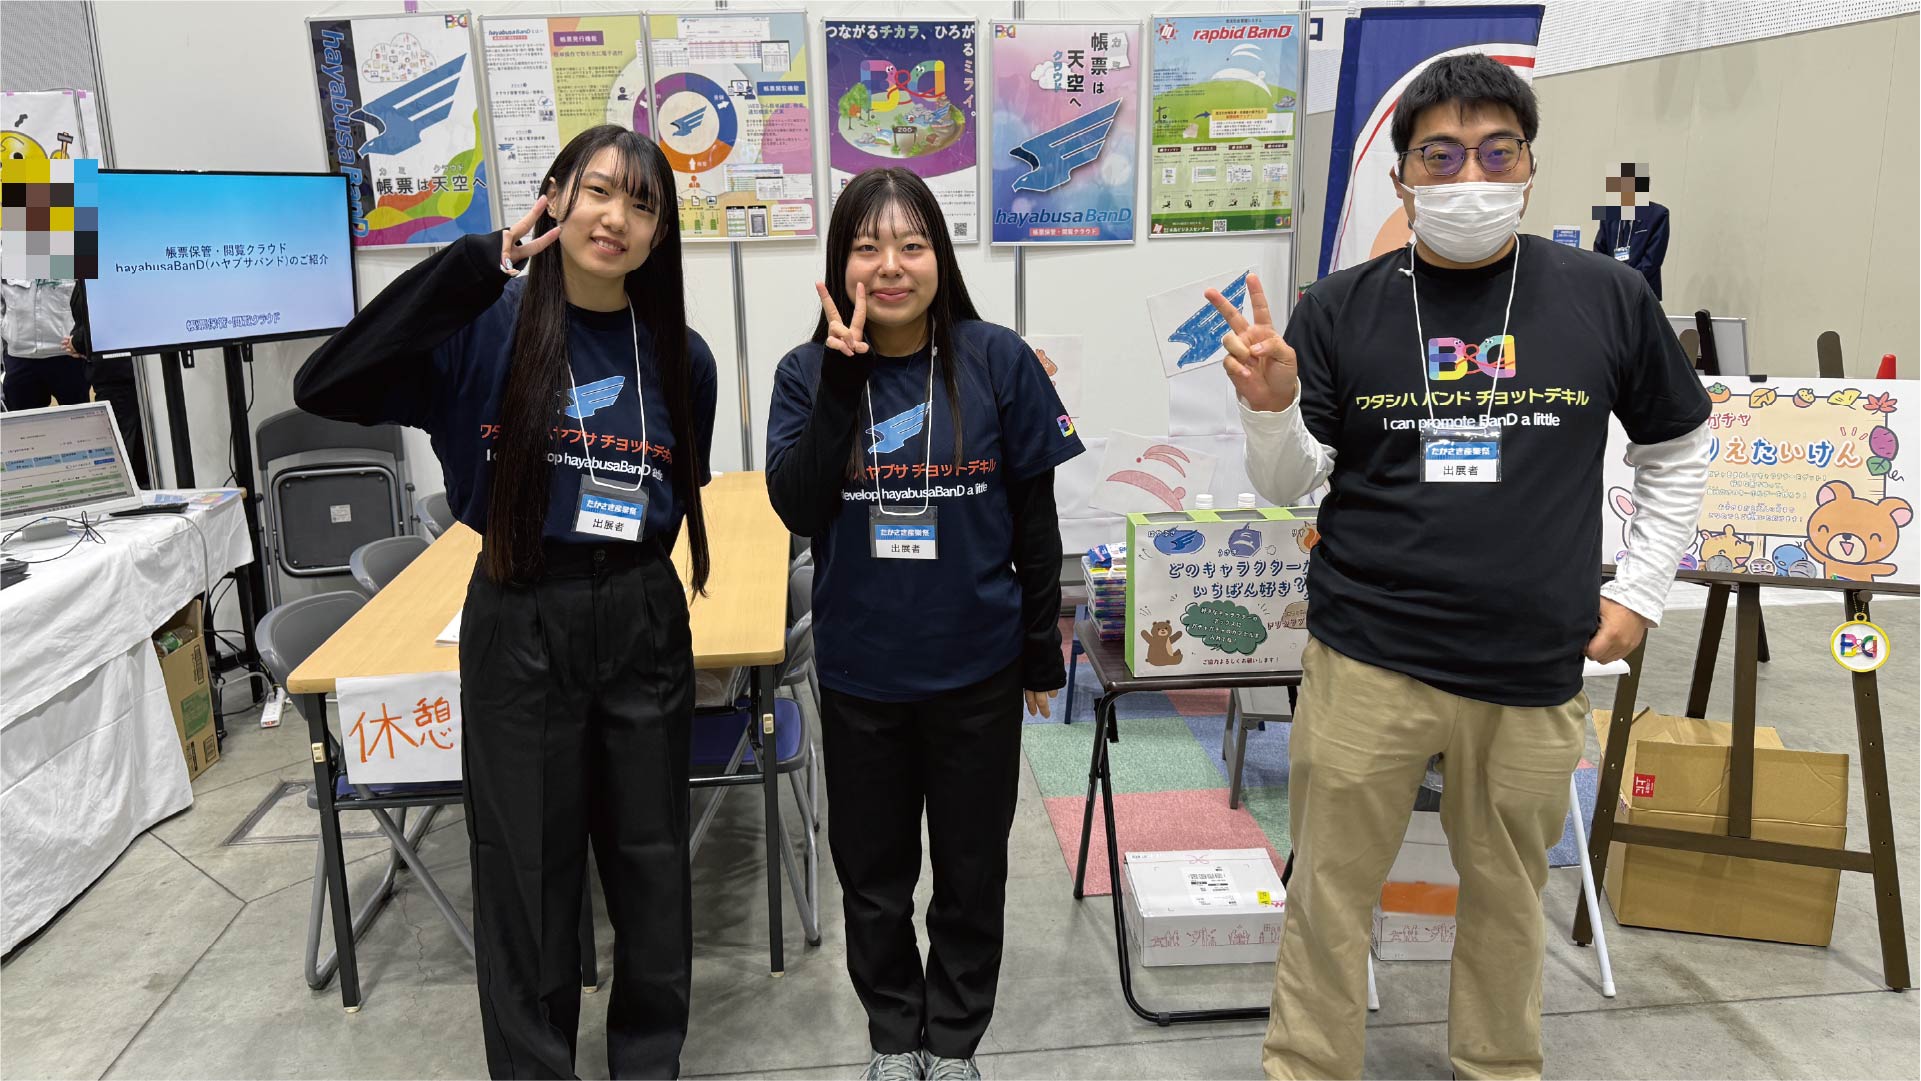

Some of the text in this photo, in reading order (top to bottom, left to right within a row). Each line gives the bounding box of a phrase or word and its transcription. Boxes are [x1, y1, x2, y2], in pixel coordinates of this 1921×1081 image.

[825, 24, 975, 40] つながるチカラ、ひろが
[1192, 26, 1244, 43] rapbid
[1246, 25, 1294, 39] BanD
[1091, 32, 1109, 95] 帳票は
[1067, 49, 1084, 107] 天空へ
[376, 175, 487, 195] 帳票は天空へ
[995, 208, 1132, 229] hayabusa BanD
[165, 242, 287, 259] 帳票保管・閲覧クラウド
[1355, 387, 1590, 411] ワタシハ バンド チョットデキル
[1390, 418, 1416, 430] can
[1521, 415, 1531, 426] a
[1533, 412, 1561, 426] little
[564, 452, 651, 476] hayabusaBanD
[911, 458, 996, 479] チョットデキル
[1442, 465, 1479, 476] 出展者
[881, 484, 966, 502] hayabusaBanD
[966, 486, 974, 495] a
[592, 518, 625, 532] 出展者
[891, 544, 920, 554] 出展者
[348, 696, 455, 764] 休憩
